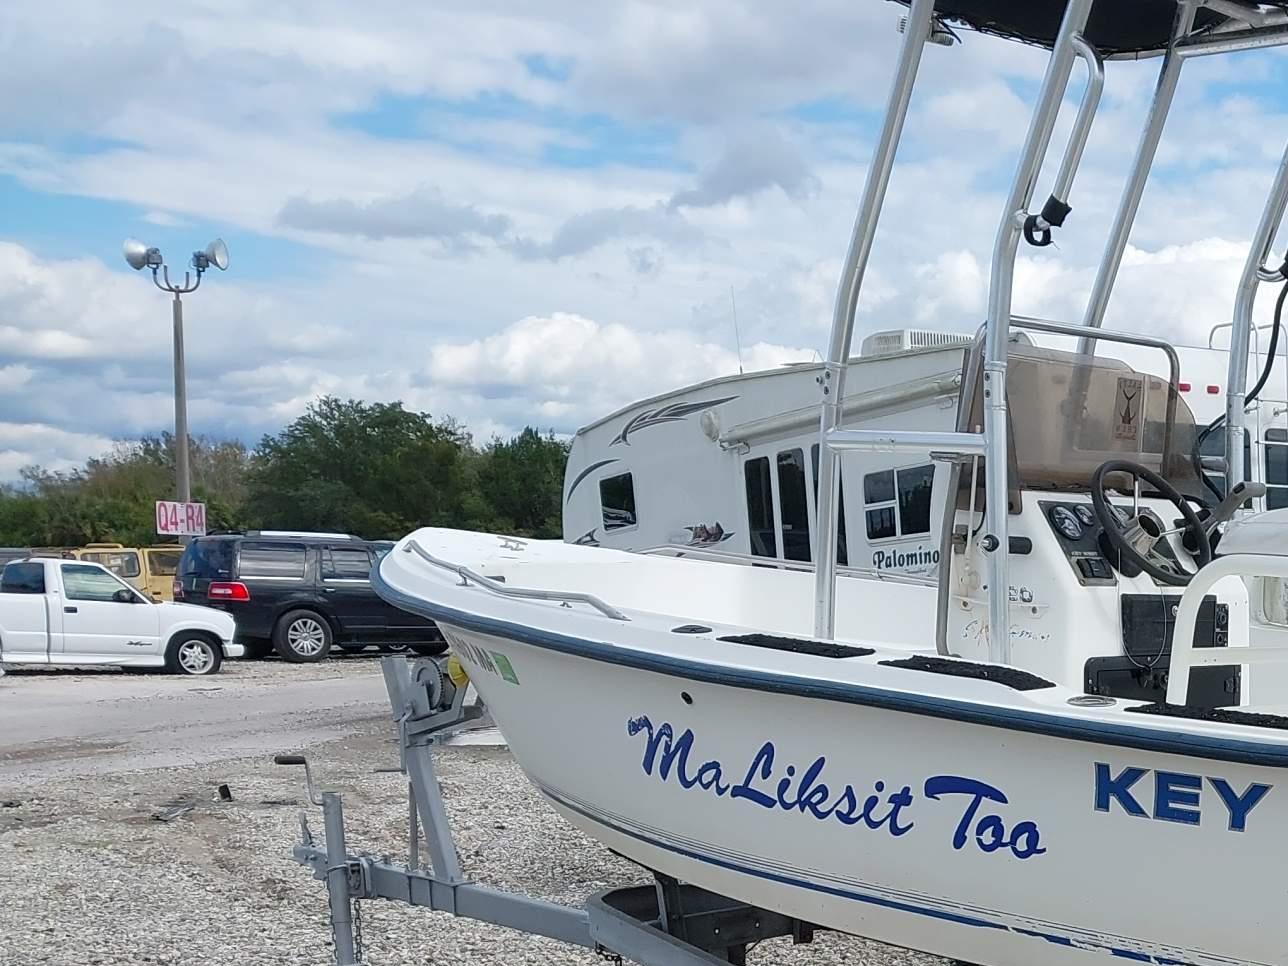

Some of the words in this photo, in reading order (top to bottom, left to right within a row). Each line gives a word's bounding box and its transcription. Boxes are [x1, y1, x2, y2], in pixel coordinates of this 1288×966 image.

[158, 502, 204, 532] Q4-R4
[872, 545, 940, 570] Palomino
[924, 775, 1047, 859] Too
[1094, 761, 1274, 833] KEY
